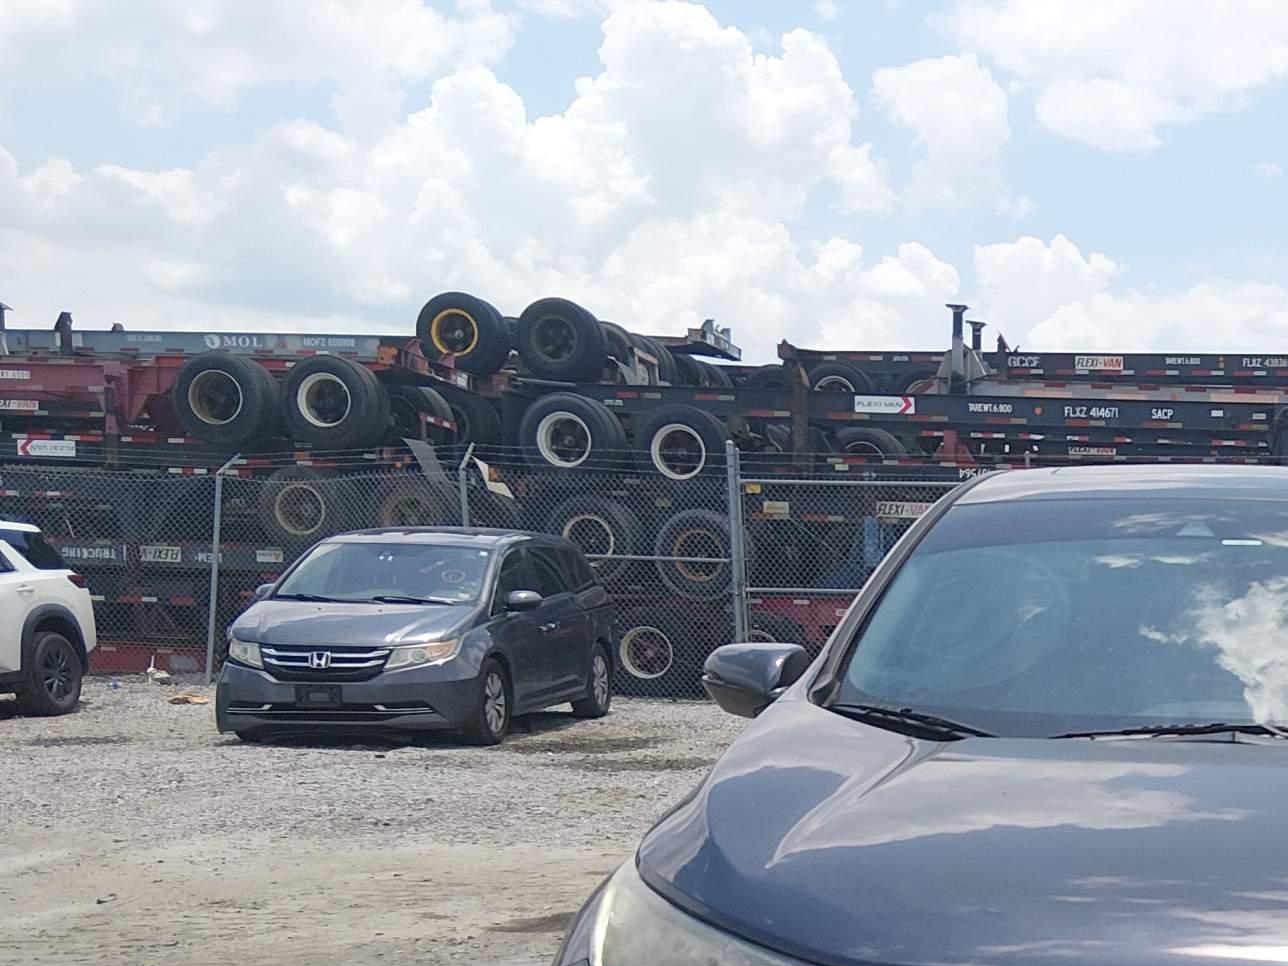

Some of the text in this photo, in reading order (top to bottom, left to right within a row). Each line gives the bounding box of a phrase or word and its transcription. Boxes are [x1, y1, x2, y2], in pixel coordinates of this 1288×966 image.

[223, 336, 263, 348] MOL
[1076, 356, 1122, 369] FLEXI-VAN
[1063, 406, 1120, 419] FLXZ 414671
[1151, 408, 1174, 420] SACP
[61, 547, 117, 559] TRUCKING
